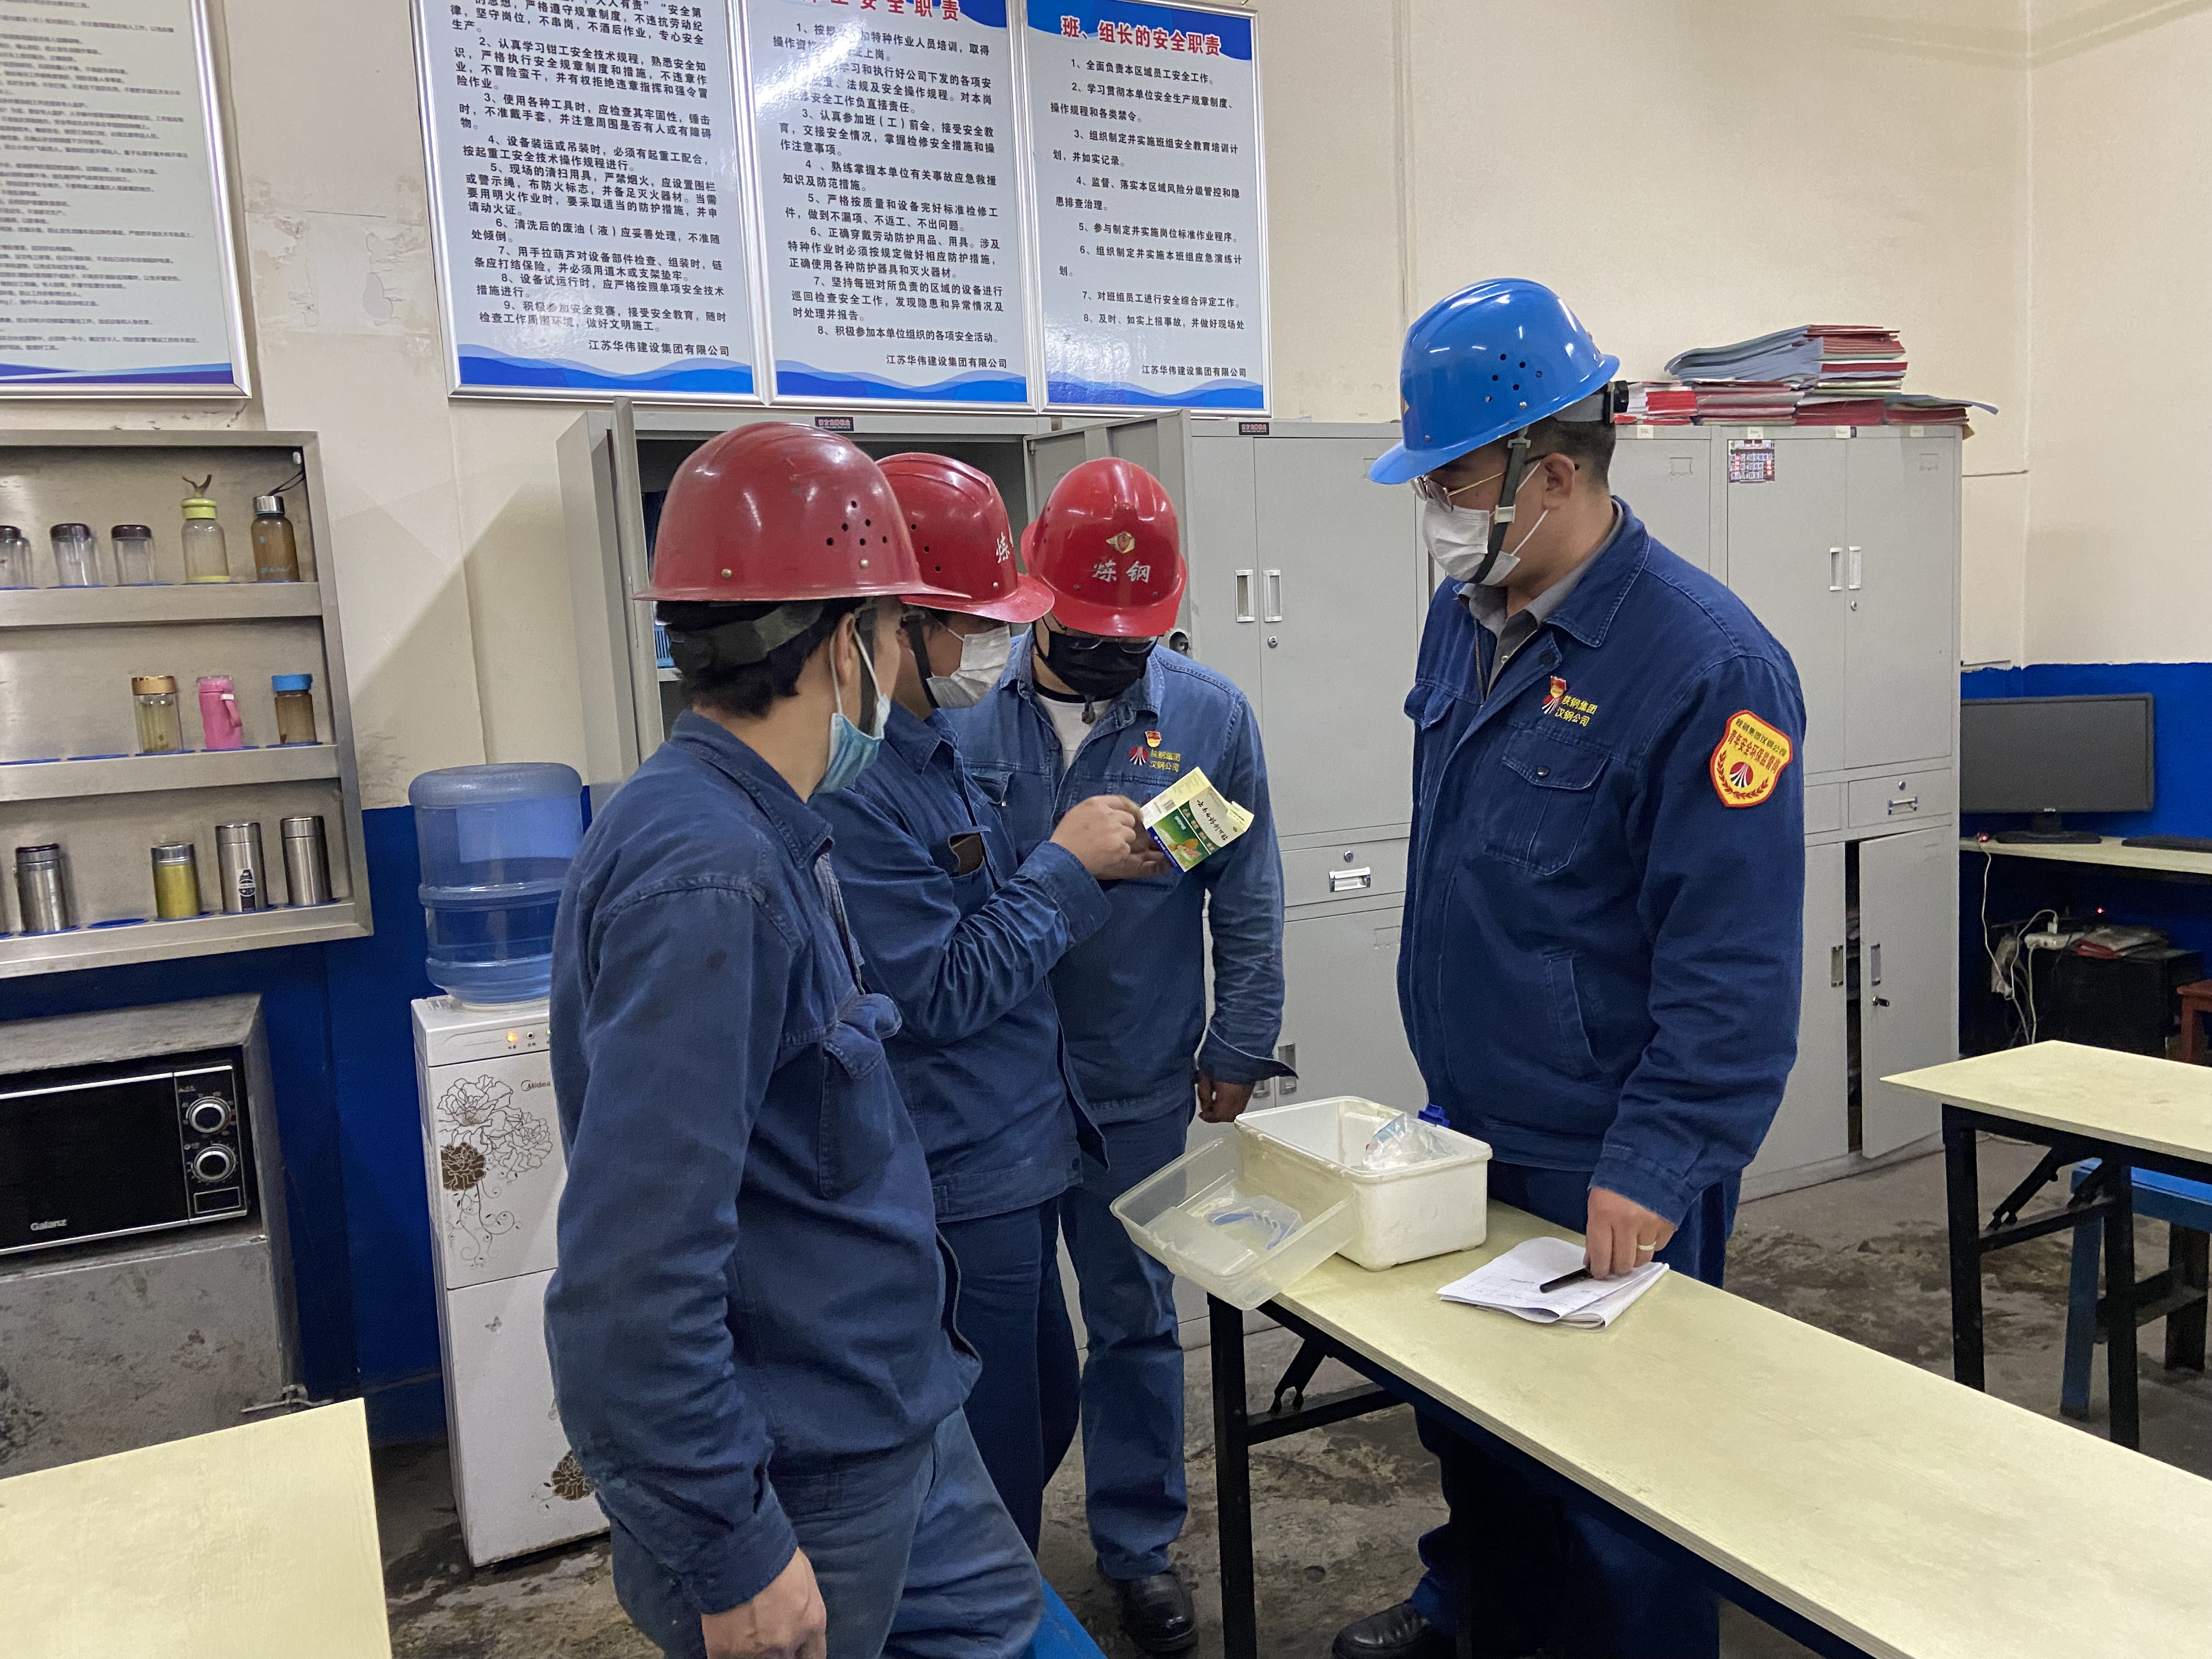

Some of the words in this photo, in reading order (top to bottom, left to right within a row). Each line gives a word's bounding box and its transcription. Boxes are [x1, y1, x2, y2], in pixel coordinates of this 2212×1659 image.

[802, 0, 959, 21] 安全职责
[452, 19, 482, 32] 生产。
[1060, 15, 1221, 56] 班、组长的安全职责
[456, 75, 499, 90] 险作业。
[1050, 103, 1141, 122] 操作规程和各类禁令。
[460, 117, 479, 130] 物。
[780, 139, 842, 156] 作注意事项。
[1052, 150, 1125, 167] 划，并如实记录。
[782, 173, 866, 192] 知识及防范措施。
[468, 201, 522, 216] 请动火证。
[1056, 196, 1108, 211] 患排查治理。
[471, 229, 514, 244] 处倾倒。
[1059, 266, 1073, 276] 划。
[476, 284, 531, 298] 措施进行。
[793, 307, 865, 322] 时处理并报告。
[1092, 560, 1150, 583] 炼钢
[1562, 695, 1598, 715] 陕钢集团
[1555, 706, 1590, 727] 汉钢公司
[521, 1080, 551, 1092] Midea
[31, 1219, 67, 1231] Galanz
